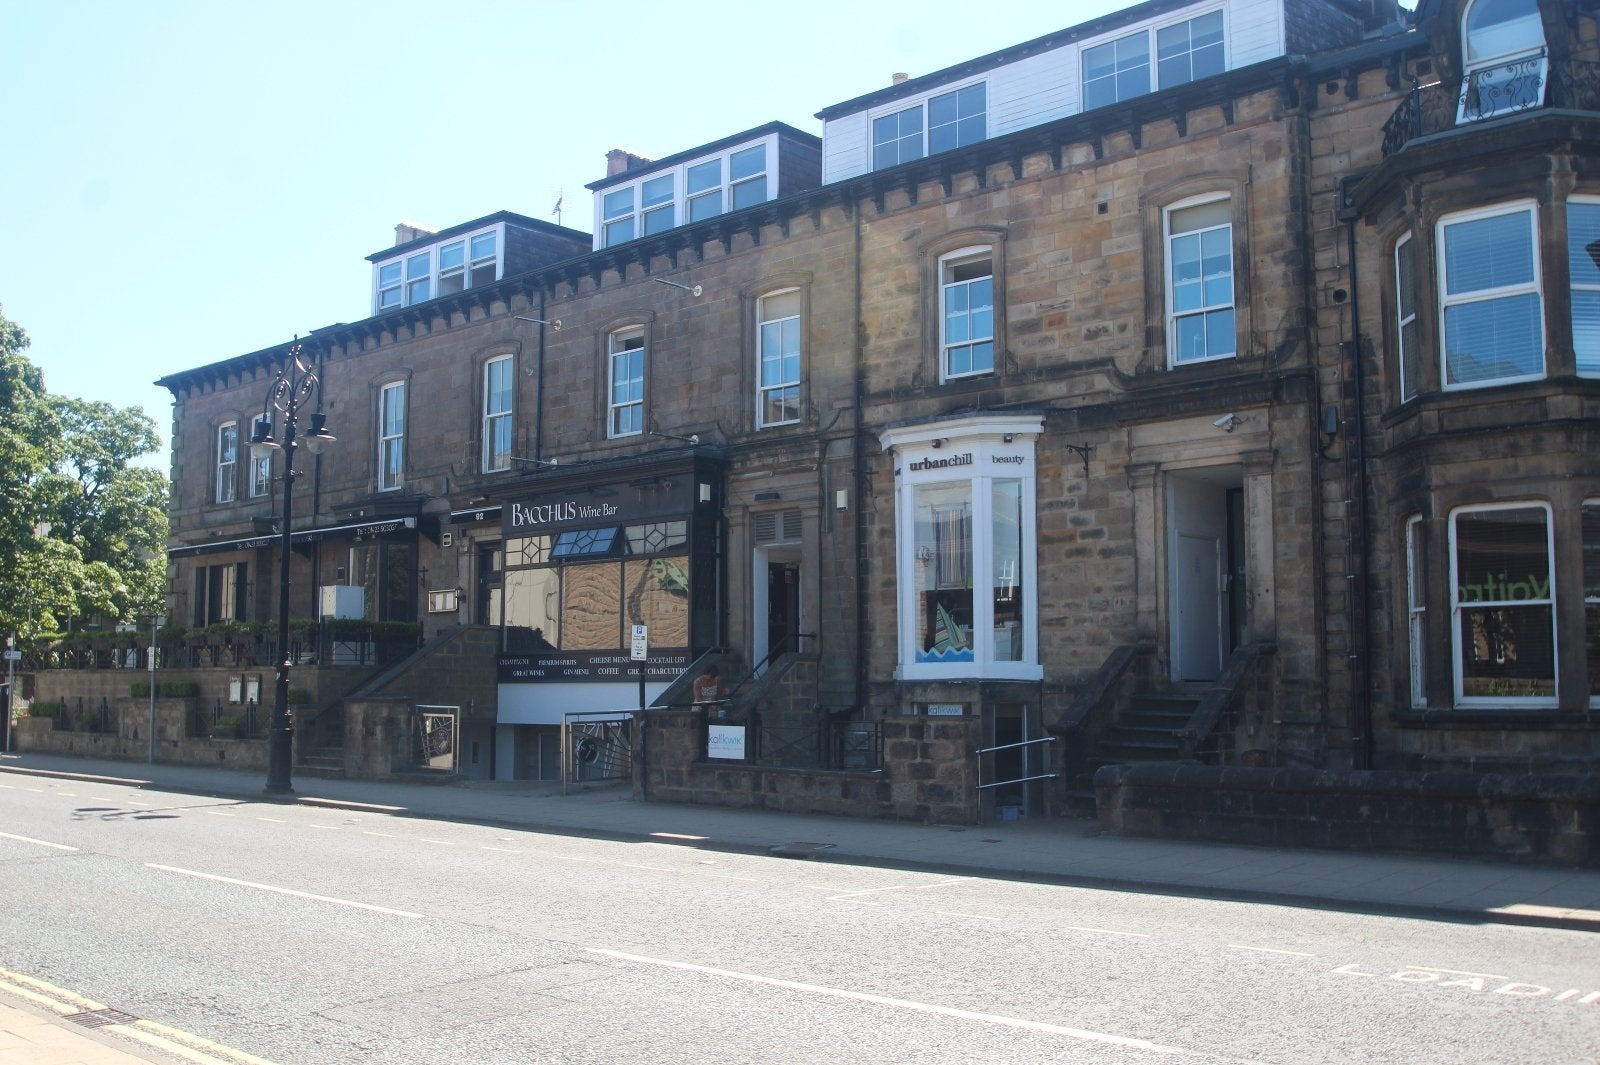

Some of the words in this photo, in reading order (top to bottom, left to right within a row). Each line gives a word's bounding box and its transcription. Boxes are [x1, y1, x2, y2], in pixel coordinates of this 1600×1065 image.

[908, 453, 973, 471] urbanchill
[991, 454, 1024, 465] beauty
[475, 512, 484, 520] 92
[512, 501, 576, 527] BACCHUS
[579, 505, 601, 518] Wine
[602, 503, 618, 516] Bar
[647, 656, 673, 664] COCKTAIL
